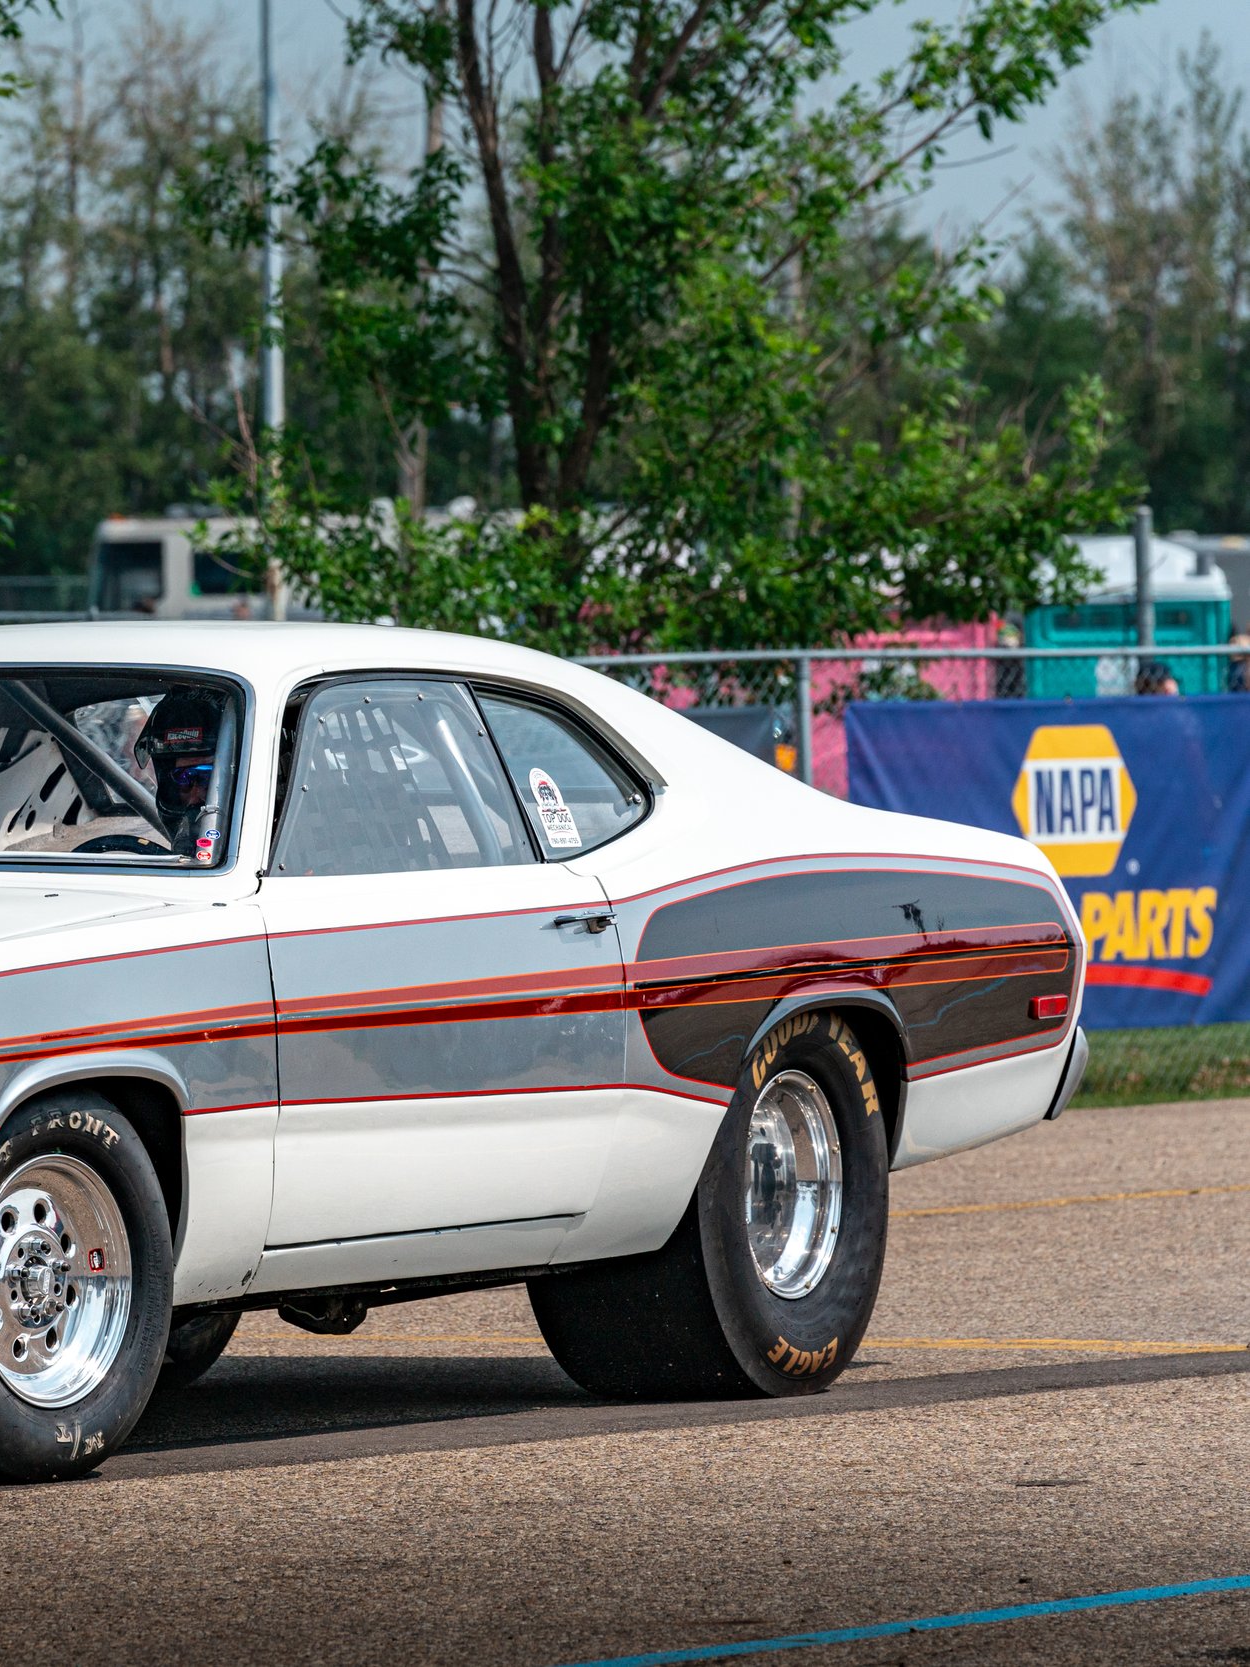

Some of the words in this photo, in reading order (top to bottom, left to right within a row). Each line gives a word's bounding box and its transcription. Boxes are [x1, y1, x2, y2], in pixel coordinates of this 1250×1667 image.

[542, 813, 556, 823] TOP
[556, 813, 572, 823] DOG
[1034, 767, 1119, 836] NAPA
[1081, 886, 1218, 961] PARTS
[29, 1108, 121, 1149] FRONT
[767, 1335, 838, 1375] EAGLE
